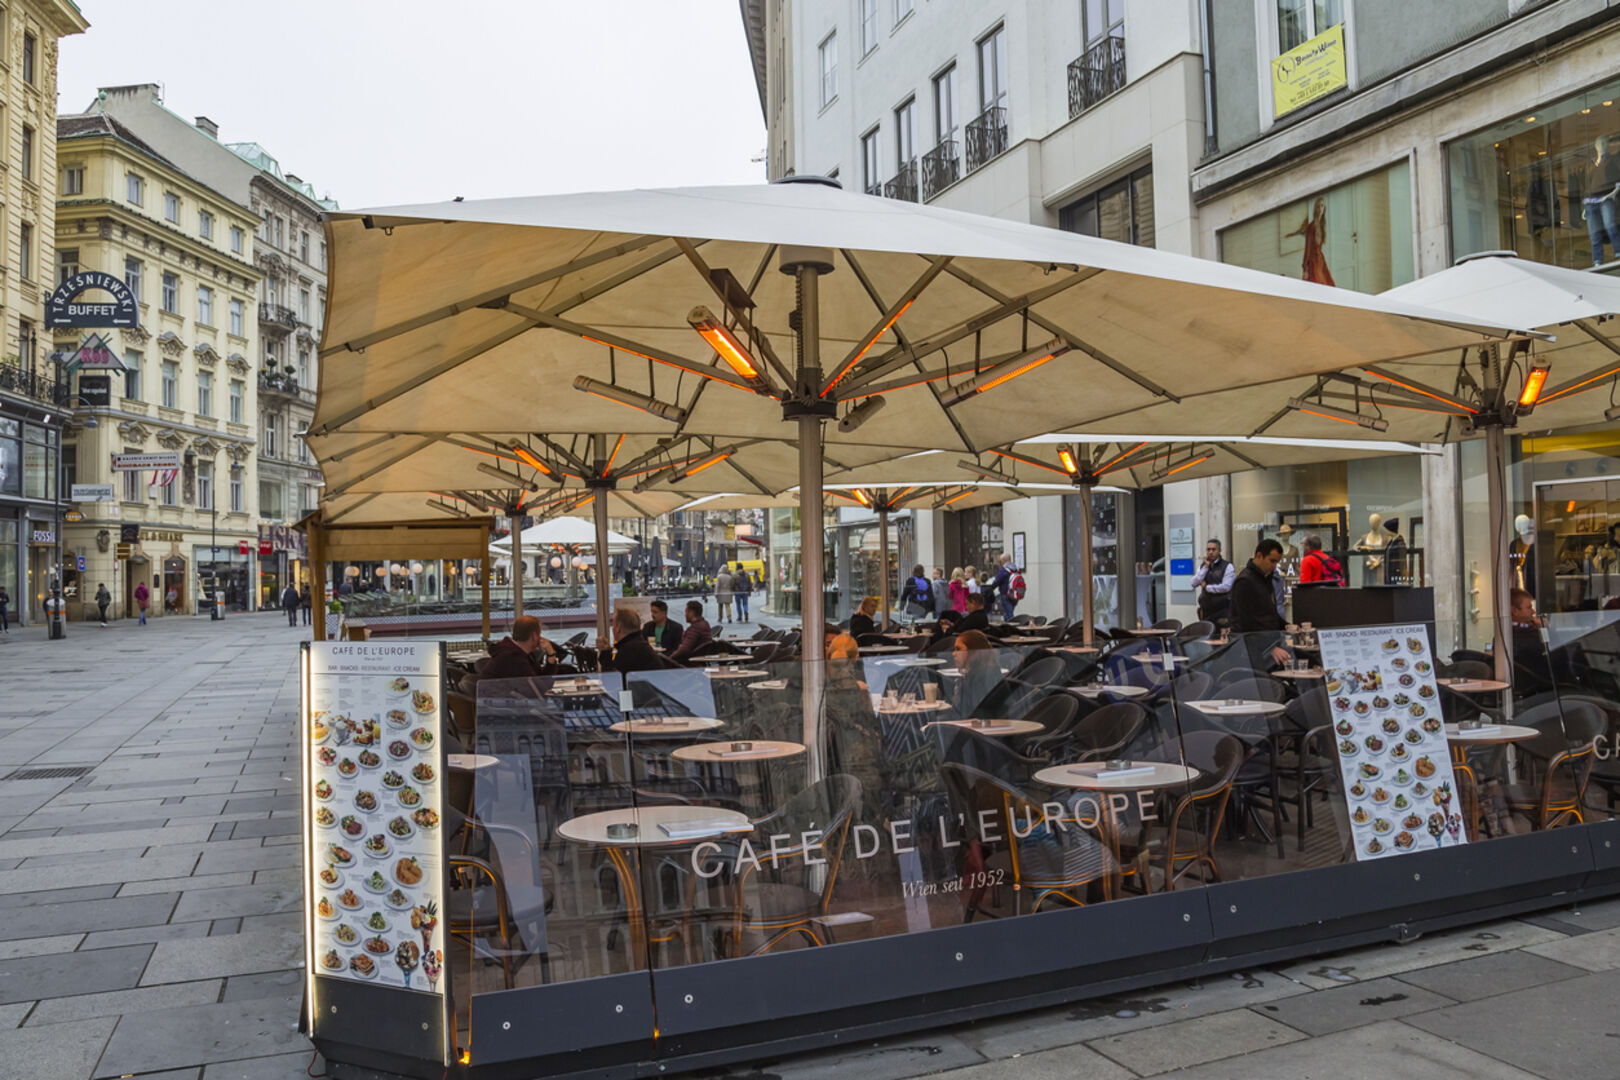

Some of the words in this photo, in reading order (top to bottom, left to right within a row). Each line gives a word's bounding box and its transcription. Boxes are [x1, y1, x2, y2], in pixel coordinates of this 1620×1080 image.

[68, 305, 117, 316] BUFFET
[1360, 628, 1393, 637] RESTAURANT
[1404, 626, 1425, 634] CREAM
[357, 646, 368, 656] DE
[691, 821, 827, 878] CAFÉ
[853, 819, 915, 859] DE
[938, 789, 1159, 849] L'EUROPE
[901, 879, 938, 898] Wien
[941, 874, 964, 894] seit
[968, 868, 1005, 891] 1952
